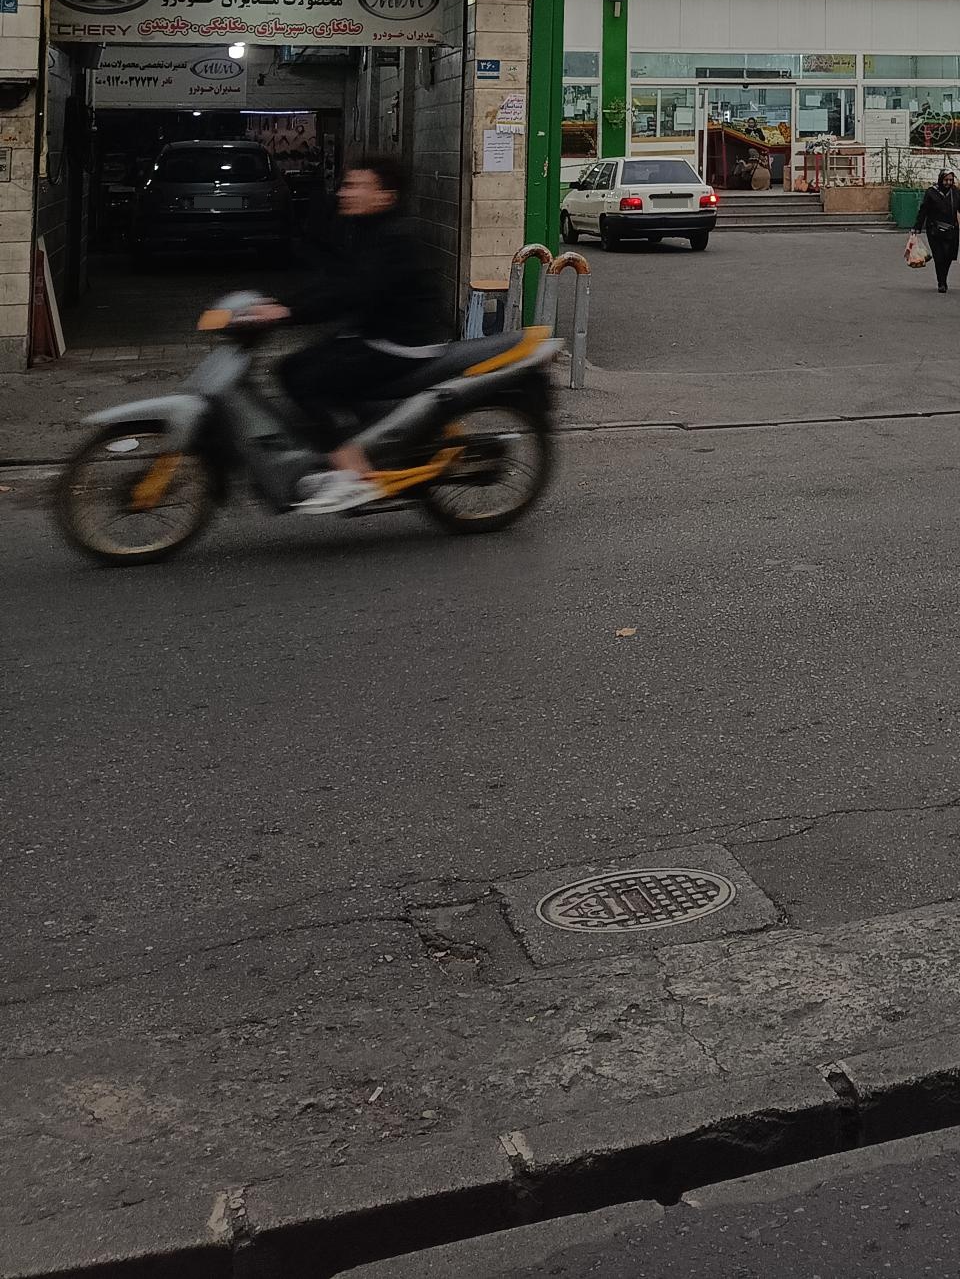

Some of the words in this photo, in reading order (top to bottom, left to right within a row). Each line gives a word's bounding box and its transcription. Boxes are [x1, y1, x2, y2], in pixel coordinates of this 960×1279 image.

[56, 24, 132, 36] CHERY
[138, 16, 192, 36] جلوبندی
[198, 17, 248, 37] مکانیکی
[254, 18, 306, 38] سپرسازی
[313, 18, 363, 38] صافکاری
[372, 30, 405, 40] خودرو
[406, 30, 434, 41] مدیران
[480, 61, 495, 70] ۳۶۰
[214, 84, 241, 95] مدیران
